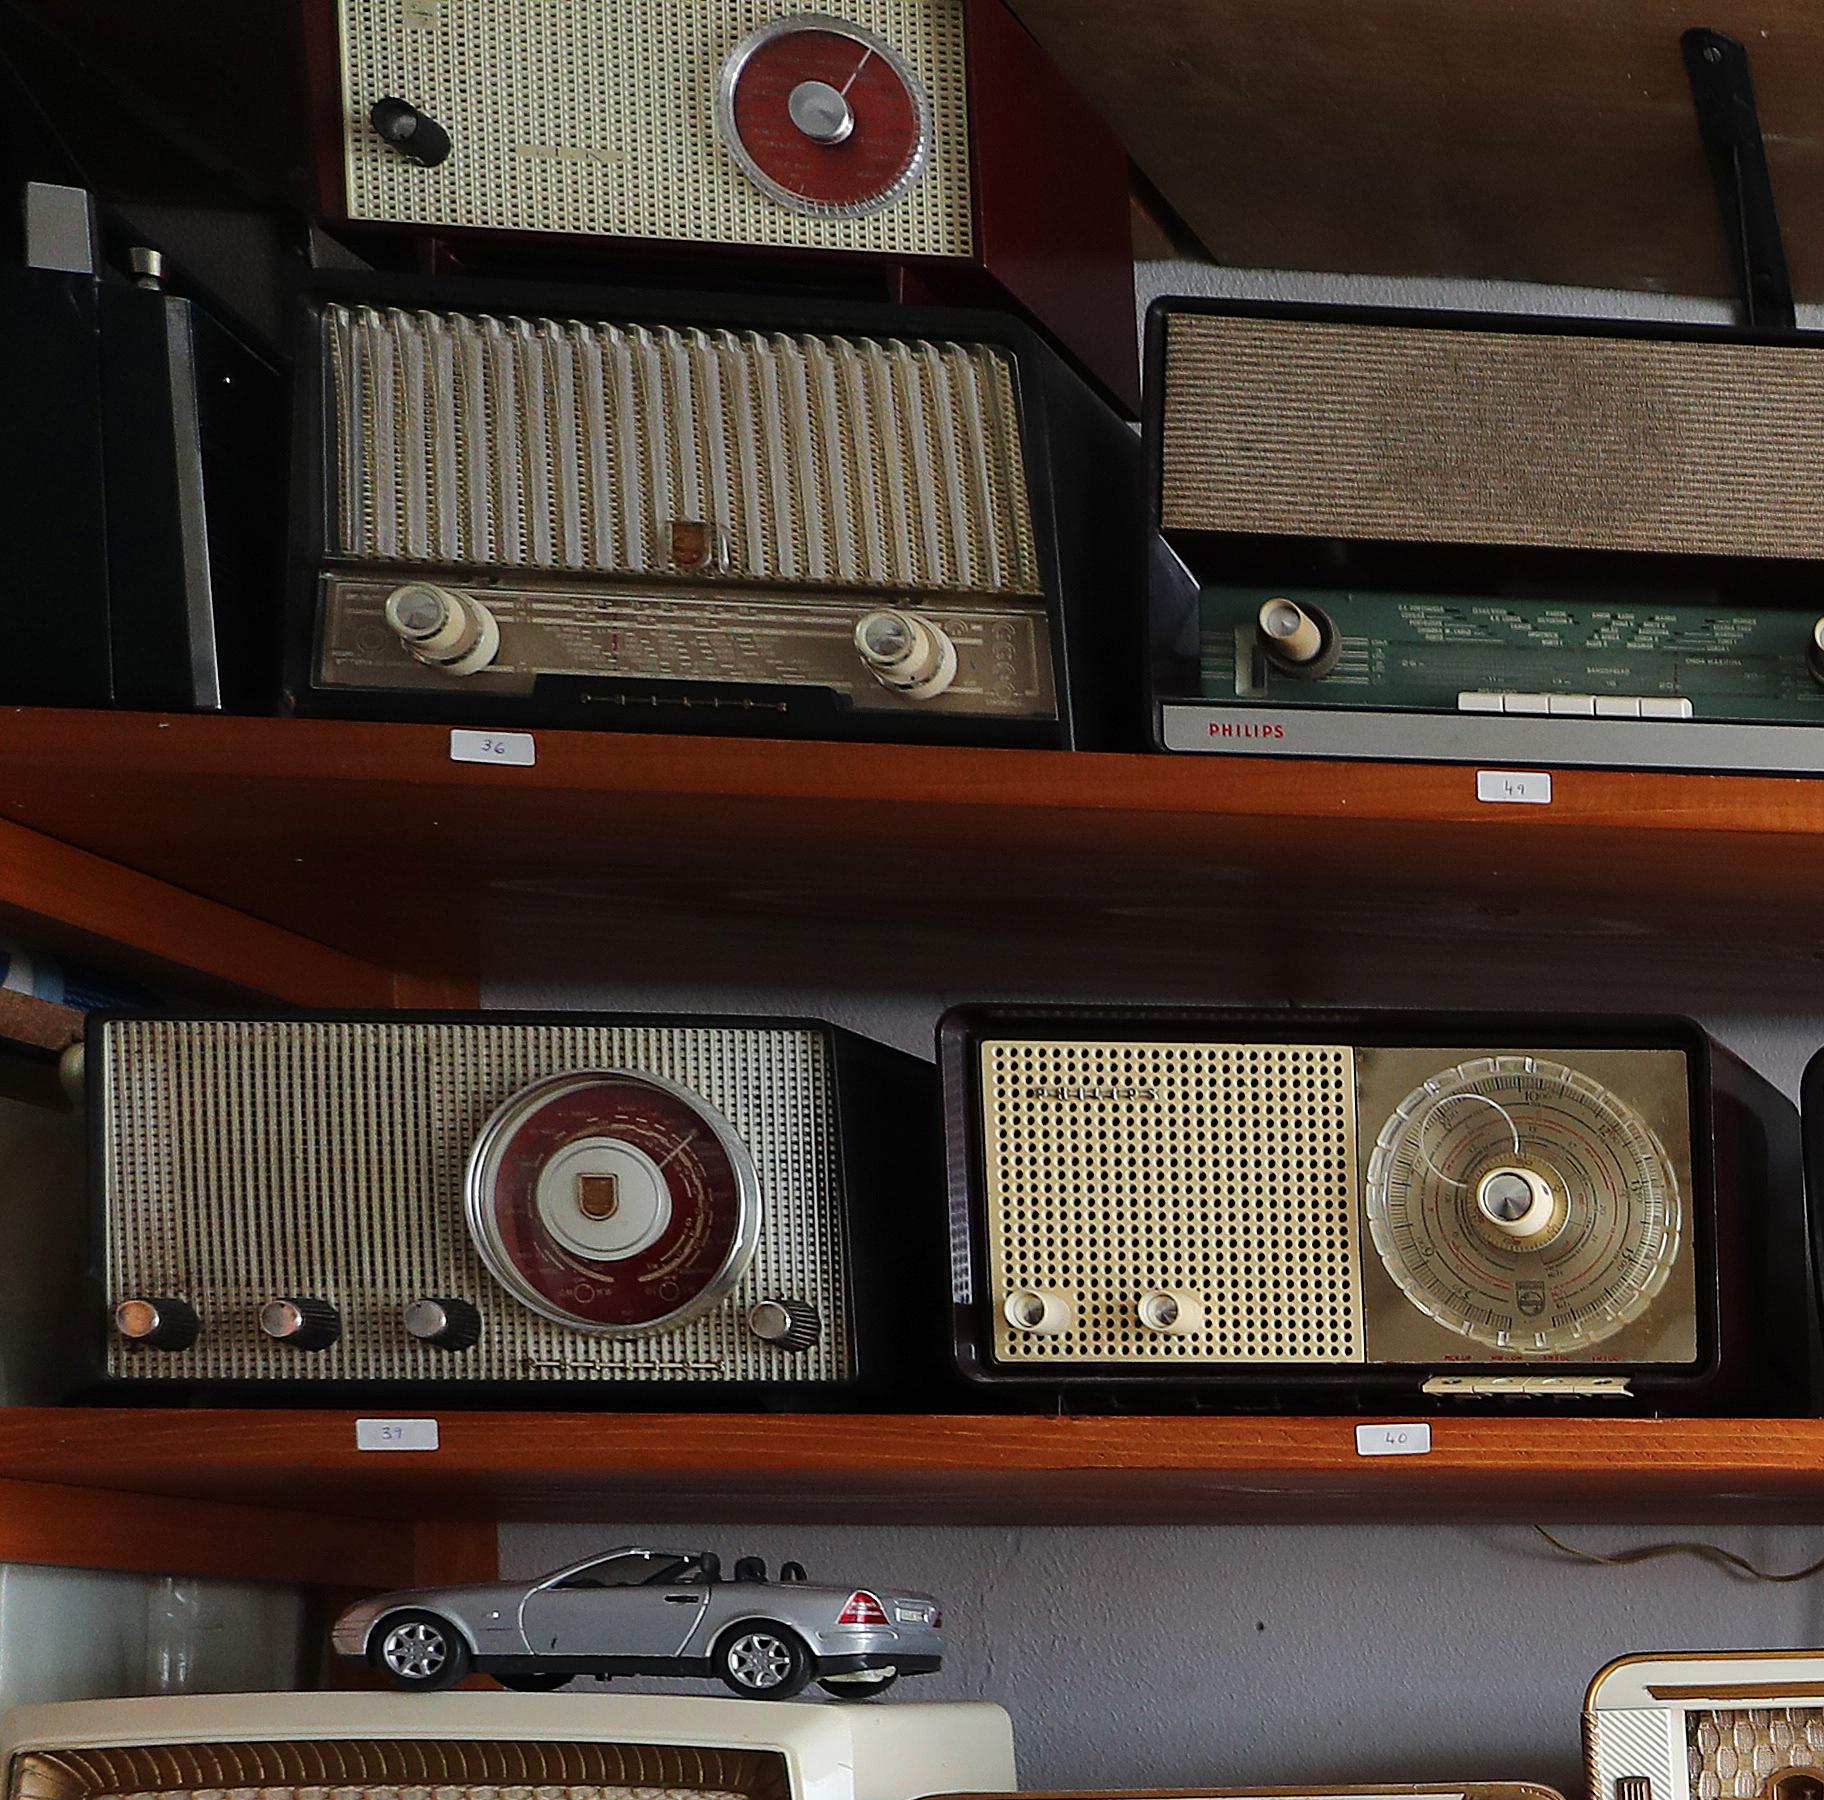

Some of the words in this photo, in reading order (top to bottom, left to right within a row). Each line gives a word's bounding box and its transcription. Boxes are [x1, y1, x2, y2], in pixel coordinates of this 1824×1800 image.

[1209, 722, 1284, 738] PHILIPS
[480, 738, 505, 755] 36
[1505, 780, 1526, 795] 49
[380, 1426, 404, 1440] 39
[1384, 1432, 1409, 1446] 40
